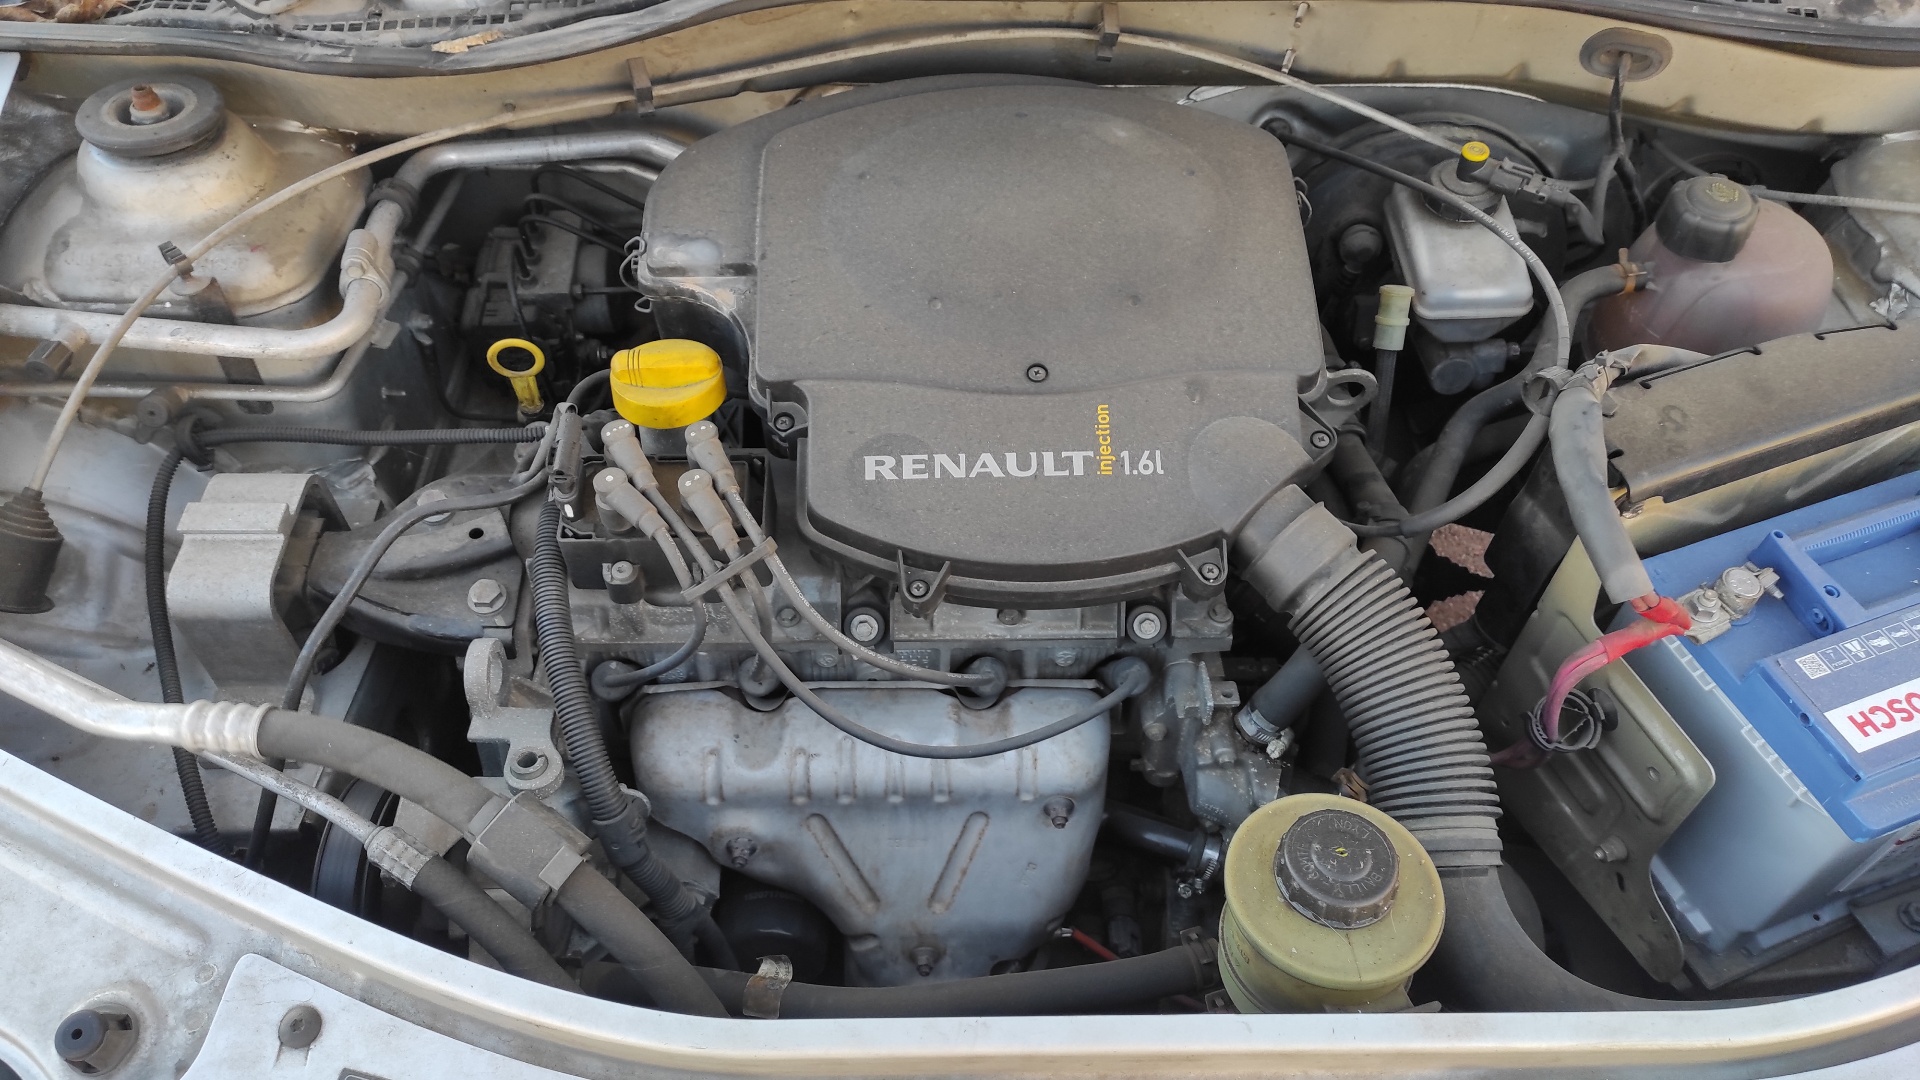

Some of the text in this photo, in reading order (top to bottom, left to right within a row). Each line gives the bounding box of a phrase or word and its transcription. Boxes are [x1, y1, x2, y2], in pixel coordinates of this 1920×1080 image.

[1096, 404, 1113, 476] injection
[863, 450, 1094, 480] RENAULT
[1847, 692, 1920, 737] OSCH
